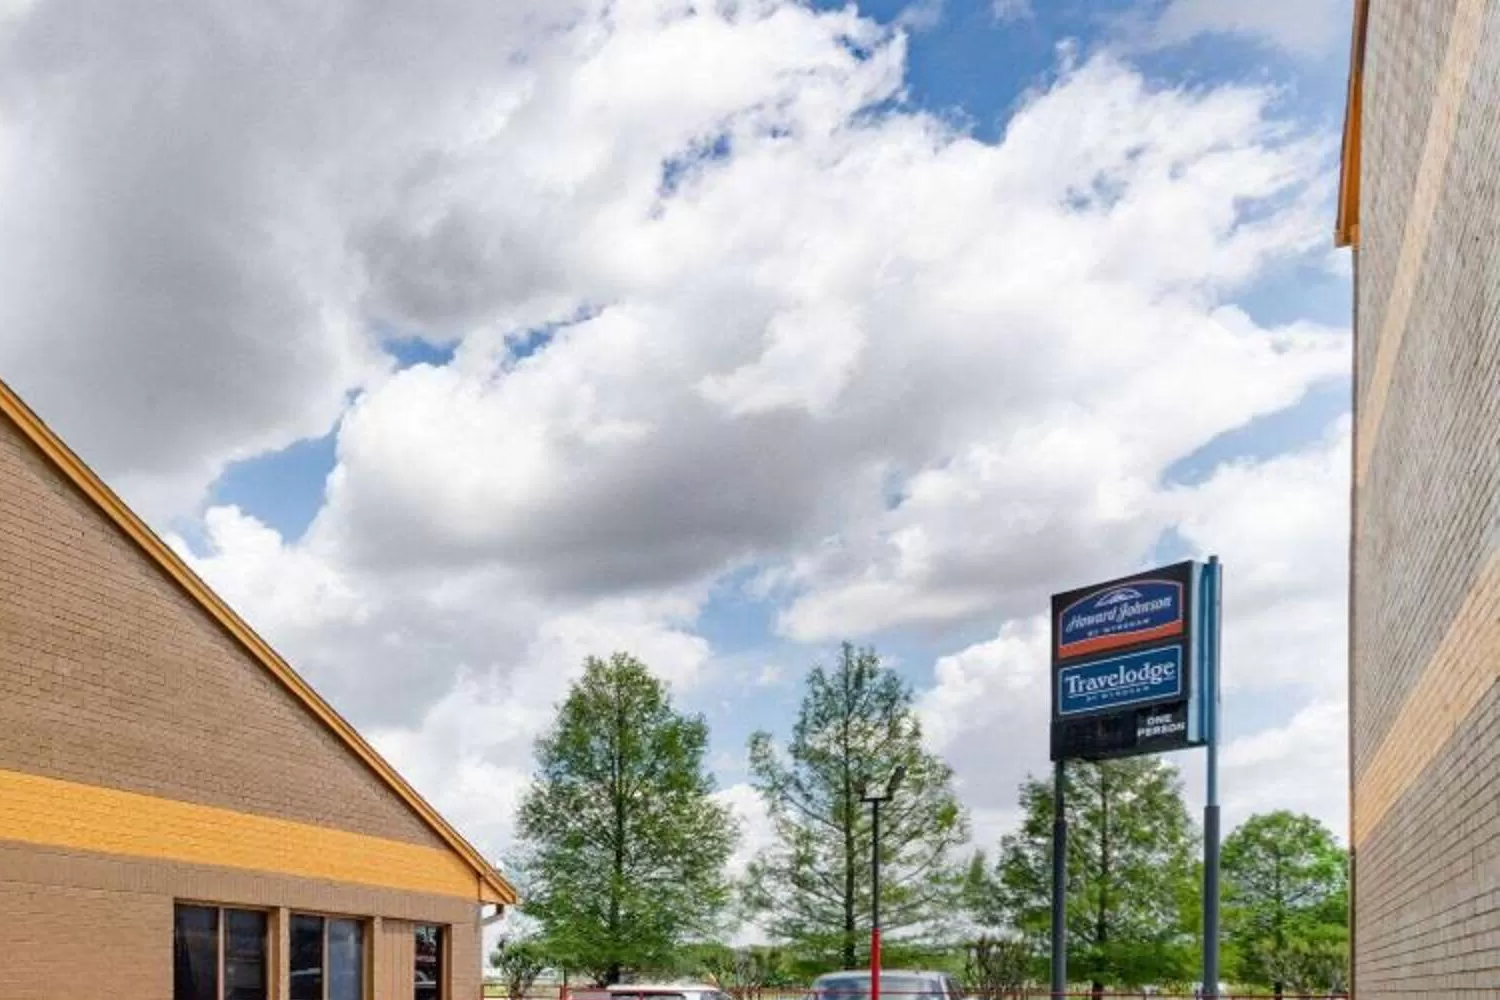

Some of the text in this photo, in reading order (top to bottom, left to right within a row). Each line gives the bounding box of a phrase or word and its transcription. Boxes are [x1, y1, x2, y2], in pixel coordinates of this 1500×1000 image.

[1065, 606, 1117, 632] Howard
[1116, 596, 1172, 622] Johnson
[1064, 662, 1176, 693] Travelodge
[1137, 722, 1186, 737] PERSON
[1147, 713, 1173, 725] ONE
